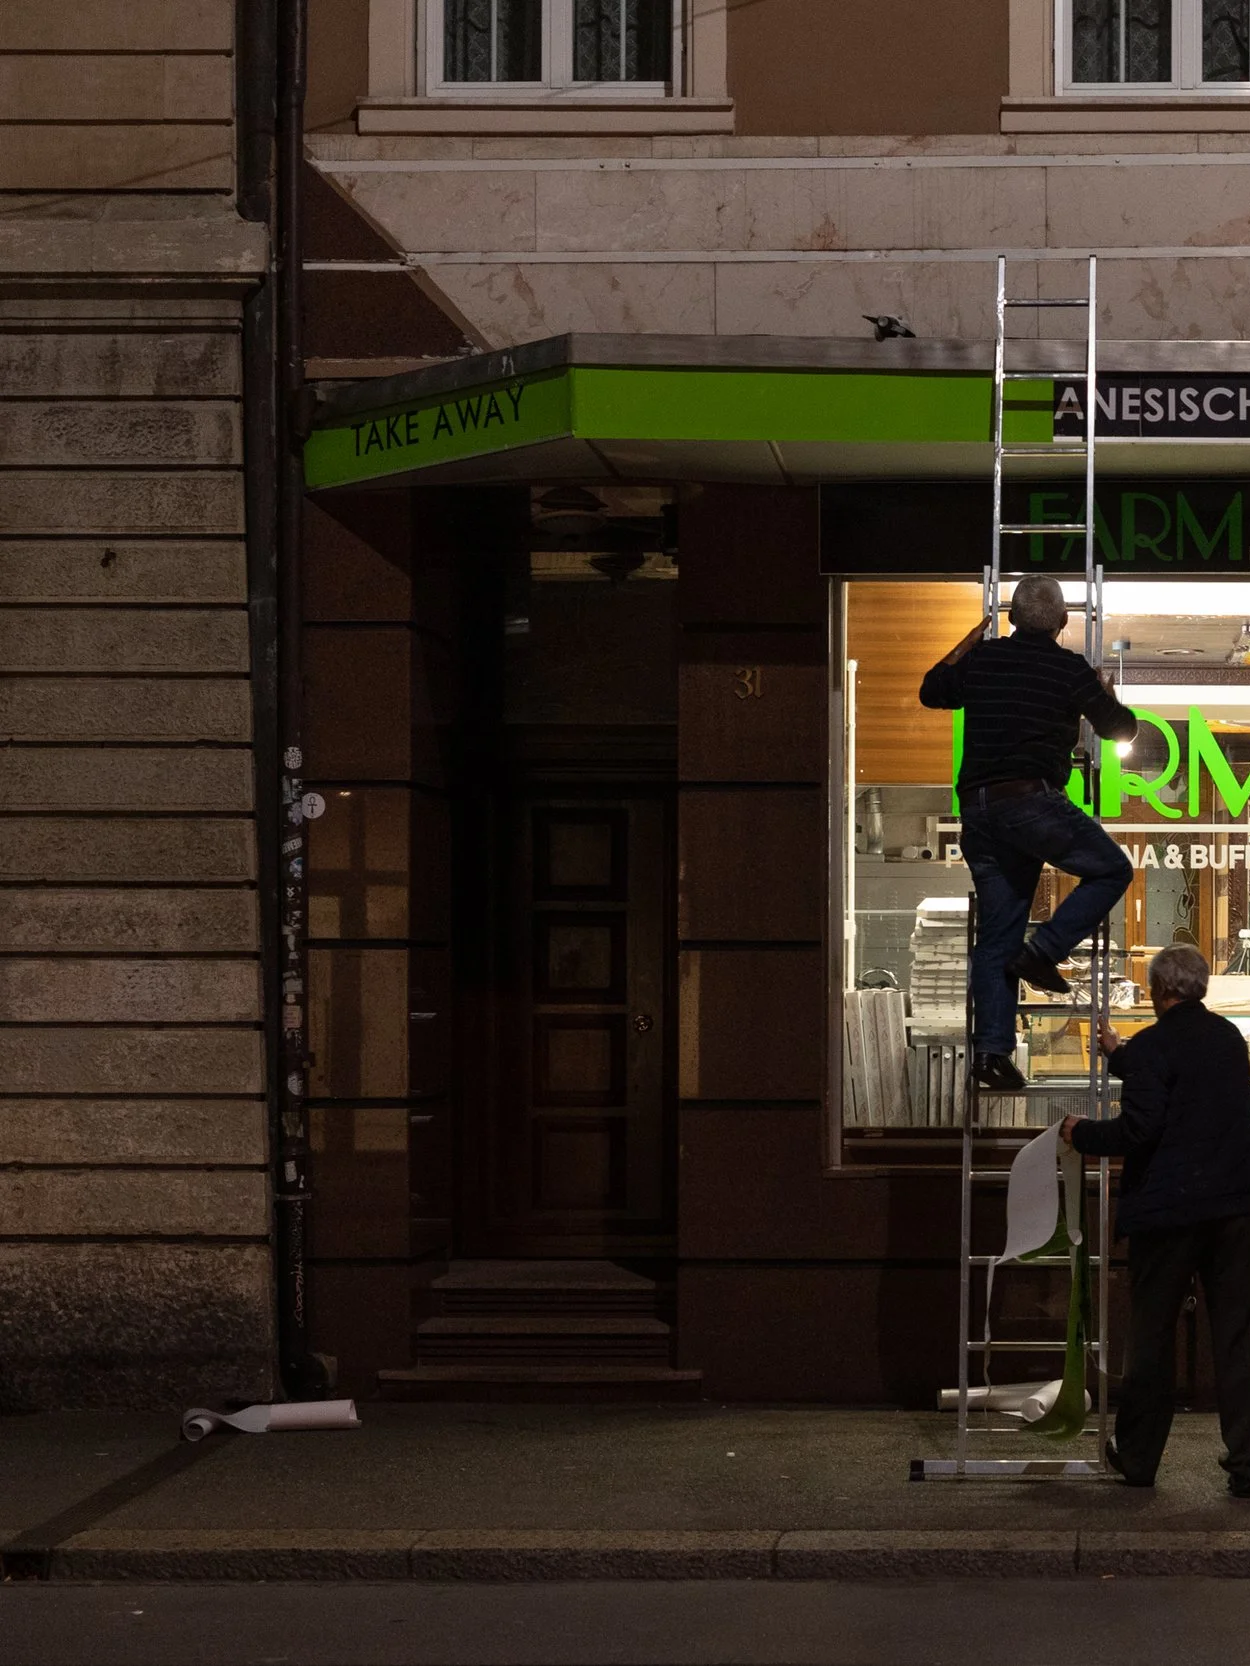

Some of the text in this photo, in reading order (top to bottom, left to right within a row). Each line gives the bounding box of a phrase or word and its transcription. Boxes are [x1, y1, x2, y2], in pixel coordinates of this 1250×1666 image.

[351, 384, 524, 457] TAKE AWAY
[1028, 490, 1243, 561] FARM
[733, 665, 765, 701] 31
[1163, 844, 1185, 869] &
